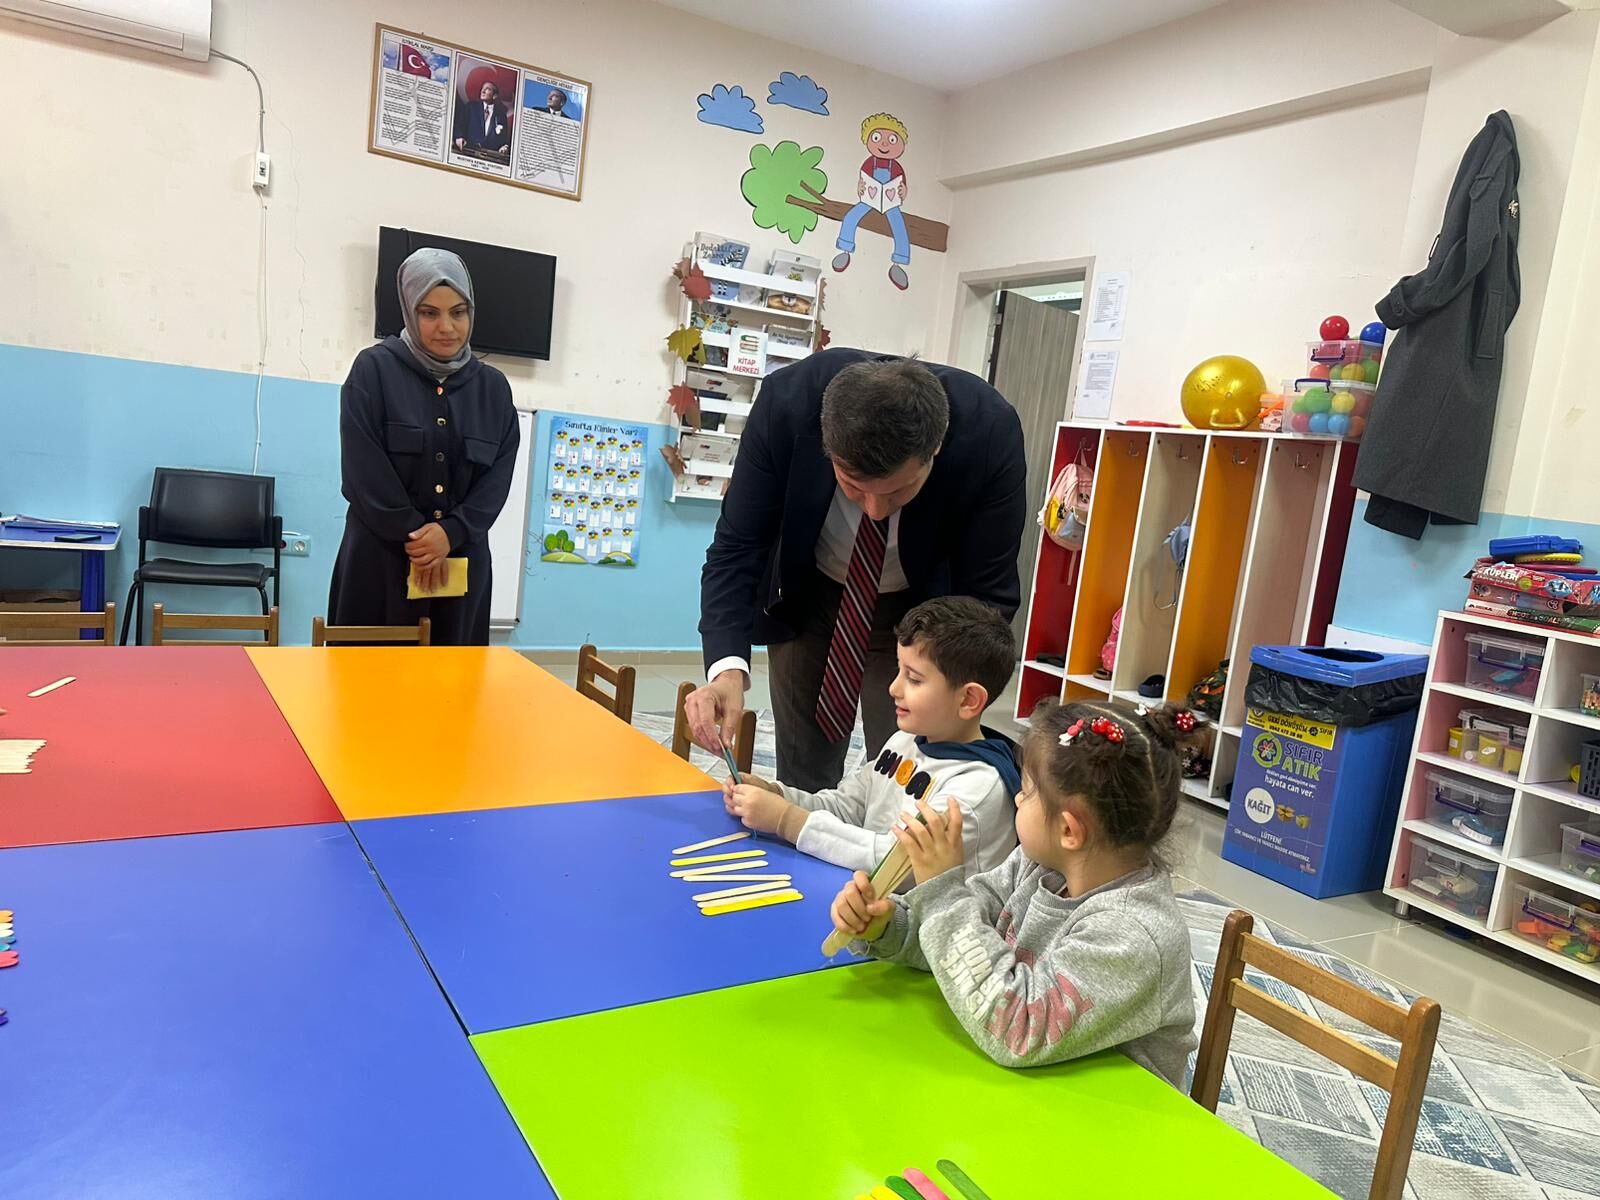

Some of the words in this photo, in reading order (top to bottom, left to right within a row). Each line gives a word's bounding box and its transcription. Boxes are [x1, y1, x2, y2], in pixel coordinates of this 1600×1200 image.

[733, 365, 760, 375] MERKEZİ
[738, 357, 757, 366] KİTAP
[1284, 741, 1324, 766] SIFIR
[1282, 757, 1322, 781] ATIK
[1265, 775, 1287, 789] hayata
[1287, 783, 1300, 792] can
[1301, 788, 1314, 799] ver.
[1247, 798, 1271, 815] KAĞIT
[951, 922, 993, 983] HOPE
